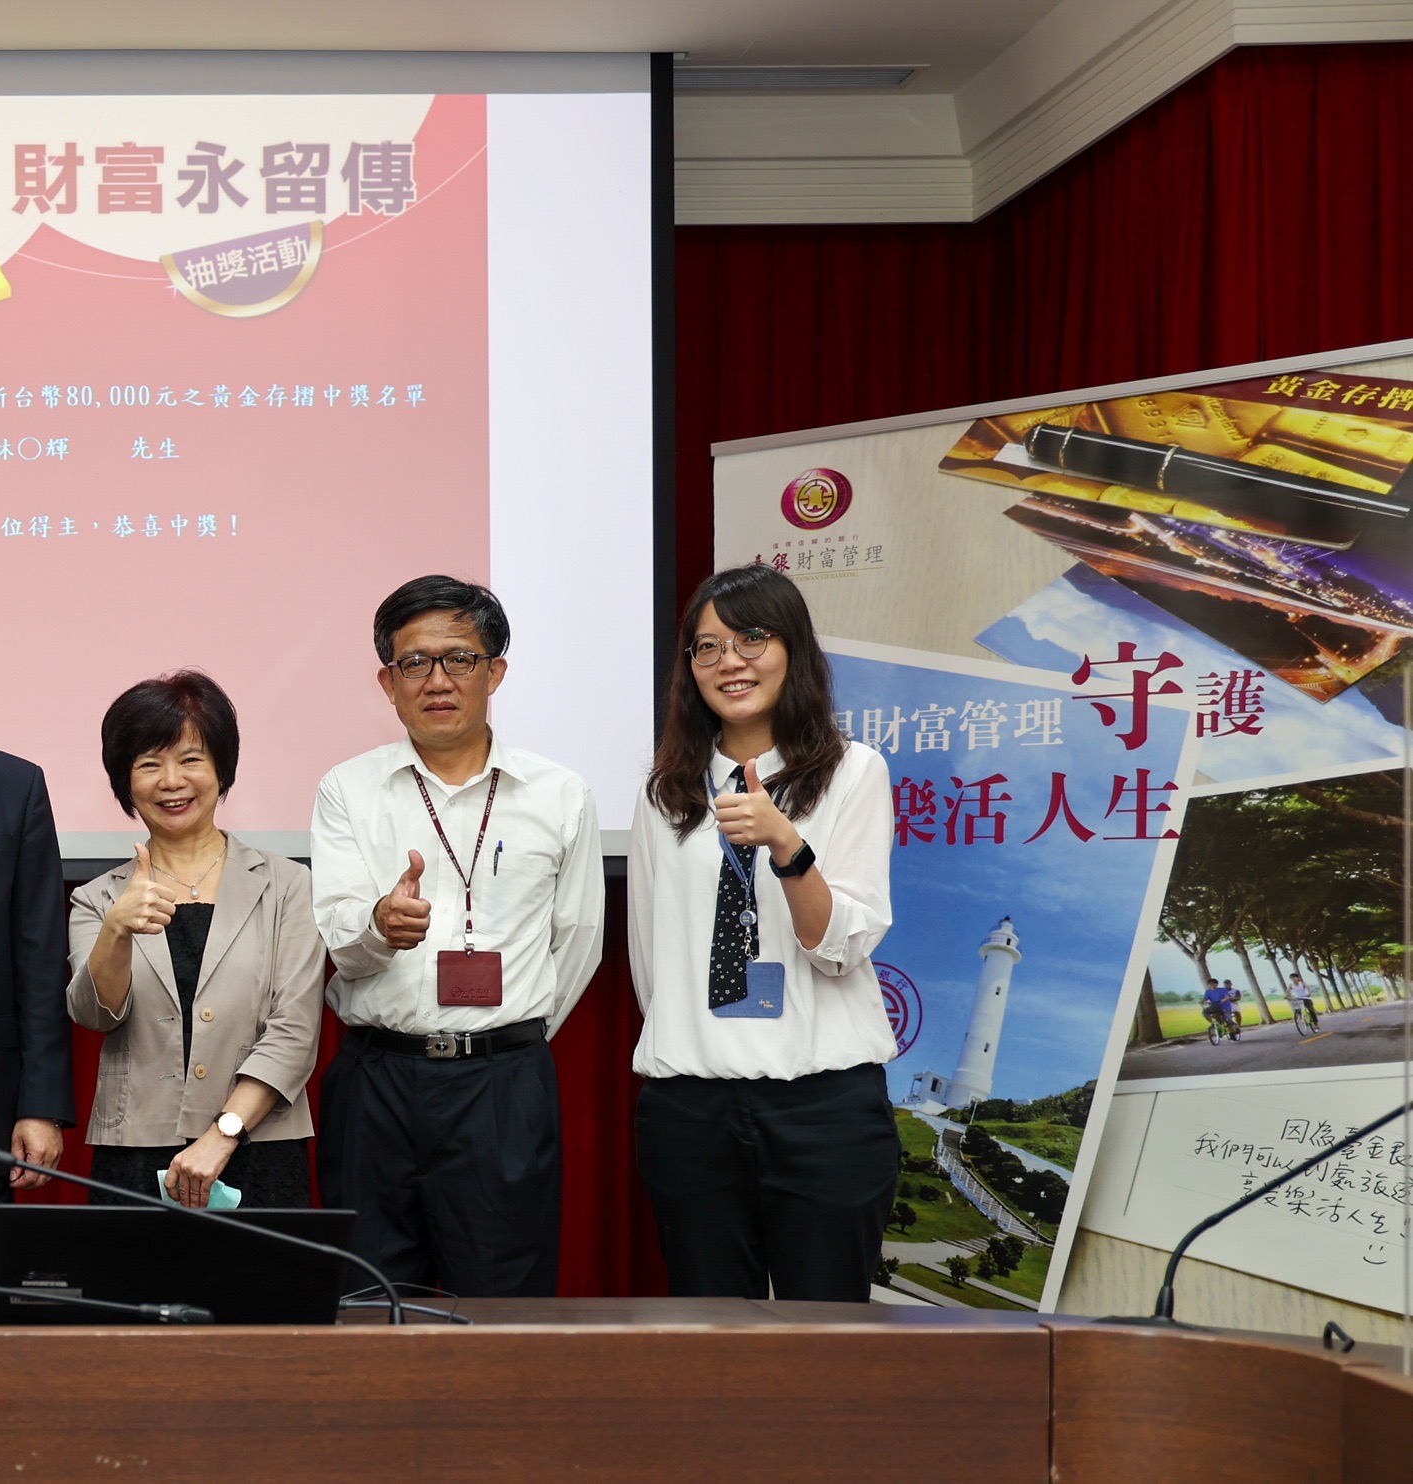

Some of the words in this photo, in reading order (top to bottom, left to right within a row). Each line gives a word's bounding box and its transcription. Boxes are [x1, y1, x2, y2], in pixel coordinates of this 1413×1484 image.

[11, 140, 416, 215] 財富永留傳
[185, 235, 309, 290] 抽獎活動
[1261, 374, 1413, 412] 黃金存摺
[130, 436, 180, 459] 先生
[1072, 641, 1266, 751] 守護
[892, 767, 1182, 847] 樂活人生
